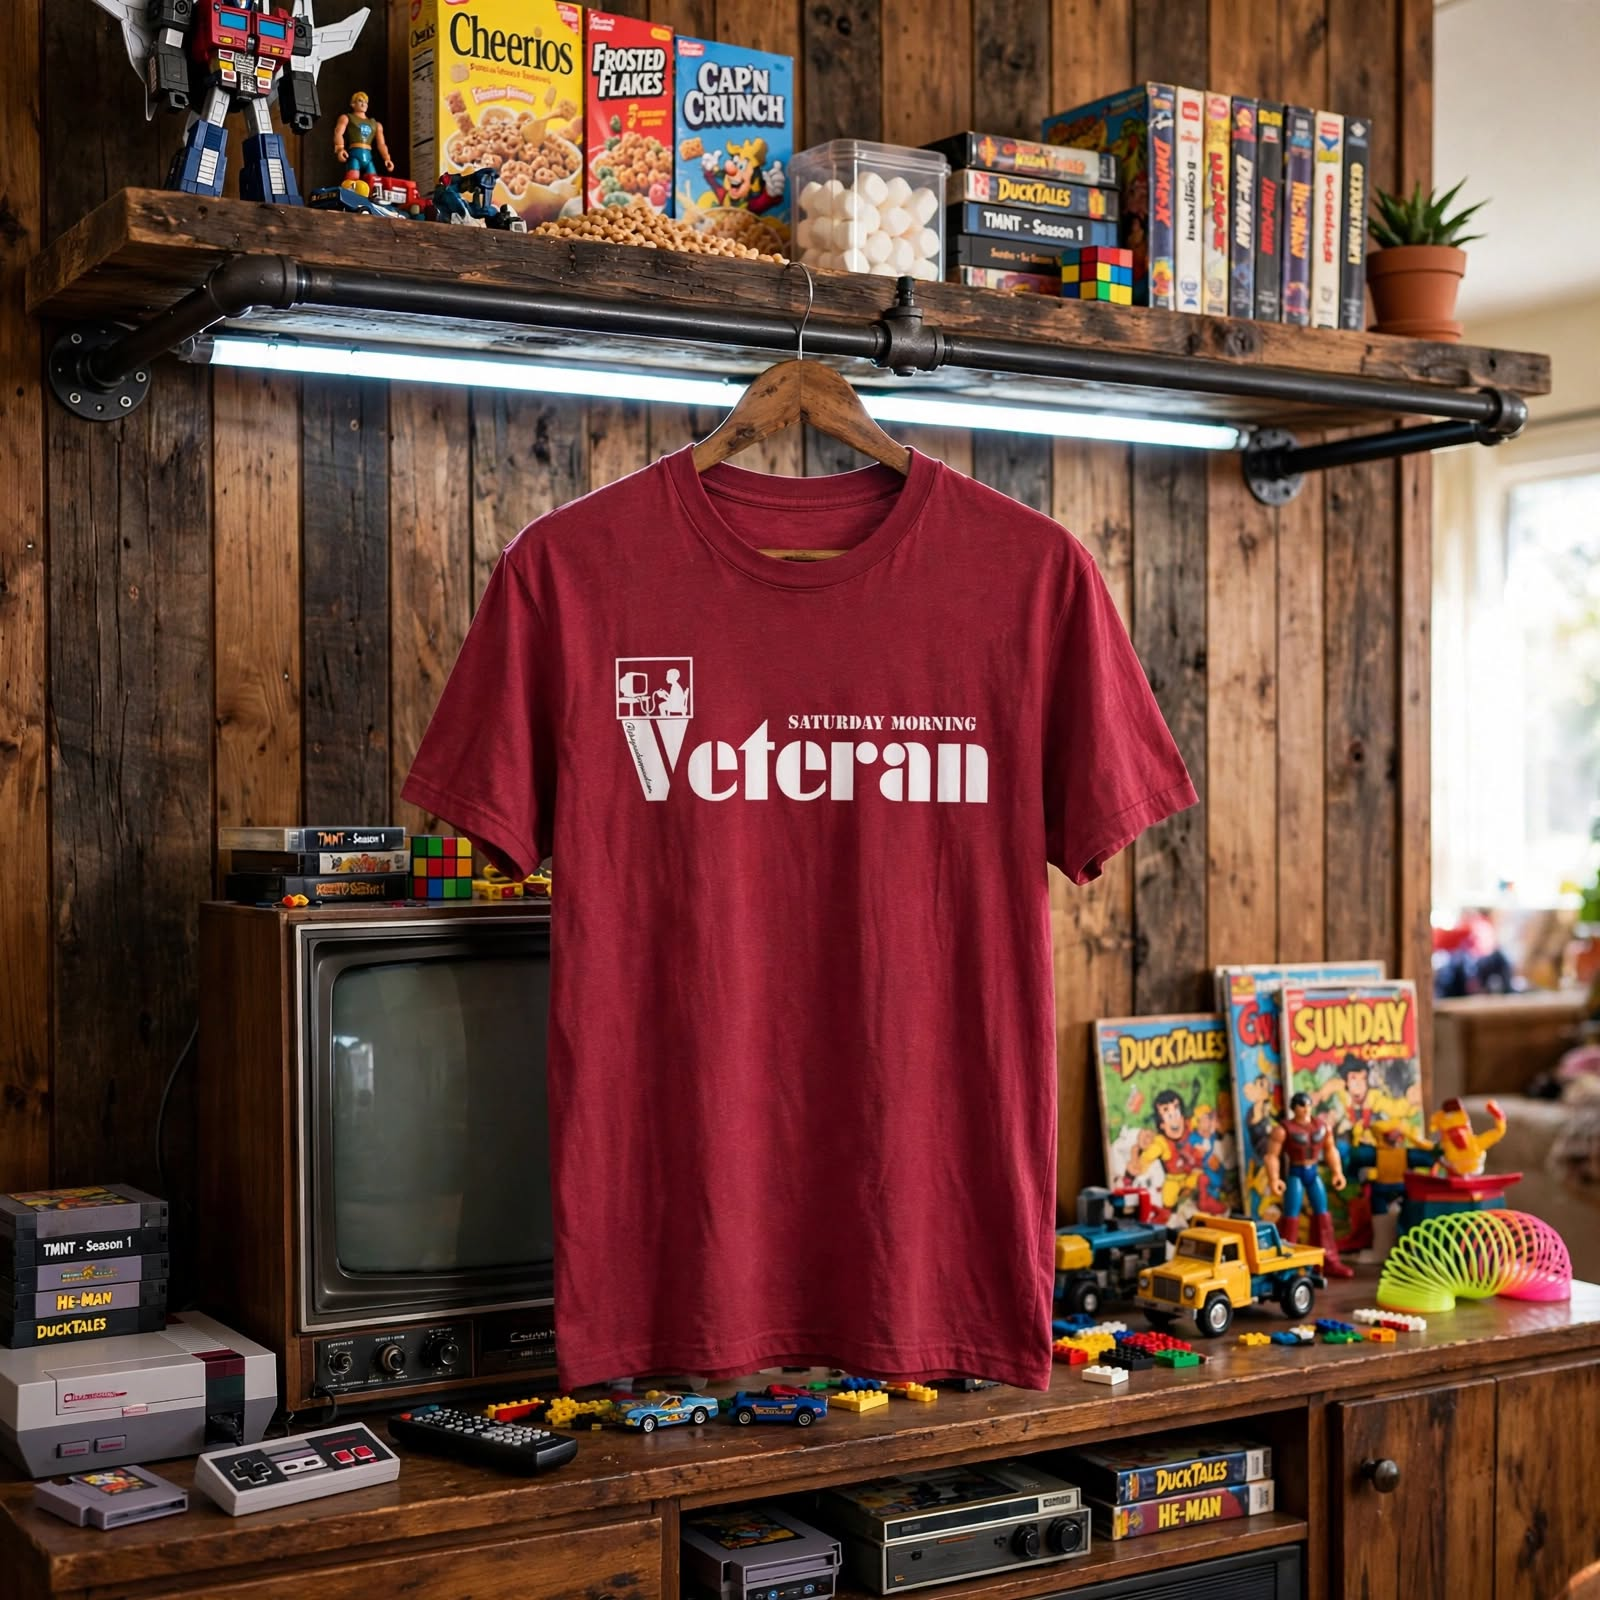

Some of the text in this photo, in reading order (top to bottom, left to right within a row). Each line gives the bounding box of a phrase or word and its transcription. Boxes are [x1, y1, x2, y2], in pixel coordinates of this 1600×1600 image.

[450, 12, 574, 76] Cheerios
[593, 43, 666, 73] FROSTED
[598, 69, 664, 99] FLAKES
[698, 61, 769, 95] CAP'N
[684, 90, 785, 126] CRUNCH
[983, 211, 1022, 232] TMNT
[1033, 219, 1074, 240] Season
[1077, 226, 1084, 241] 1
[788, 714, 977, 732] SATURDAY MORNING
[621, 719, 989, 804] Veteran
[317, 832, 345, 847] TMNT
[1292, 1000, 1408, 1057] SUNDAY
[43, 1241, 77, 1257] TMNT
[86, 1239, 123, 1252] Season
[127, 1236, 132, 1248] 1
[56, 1291, 113, 1311] HE-MAN
[1158, 1495, 1222, 1529] HE-MAN
